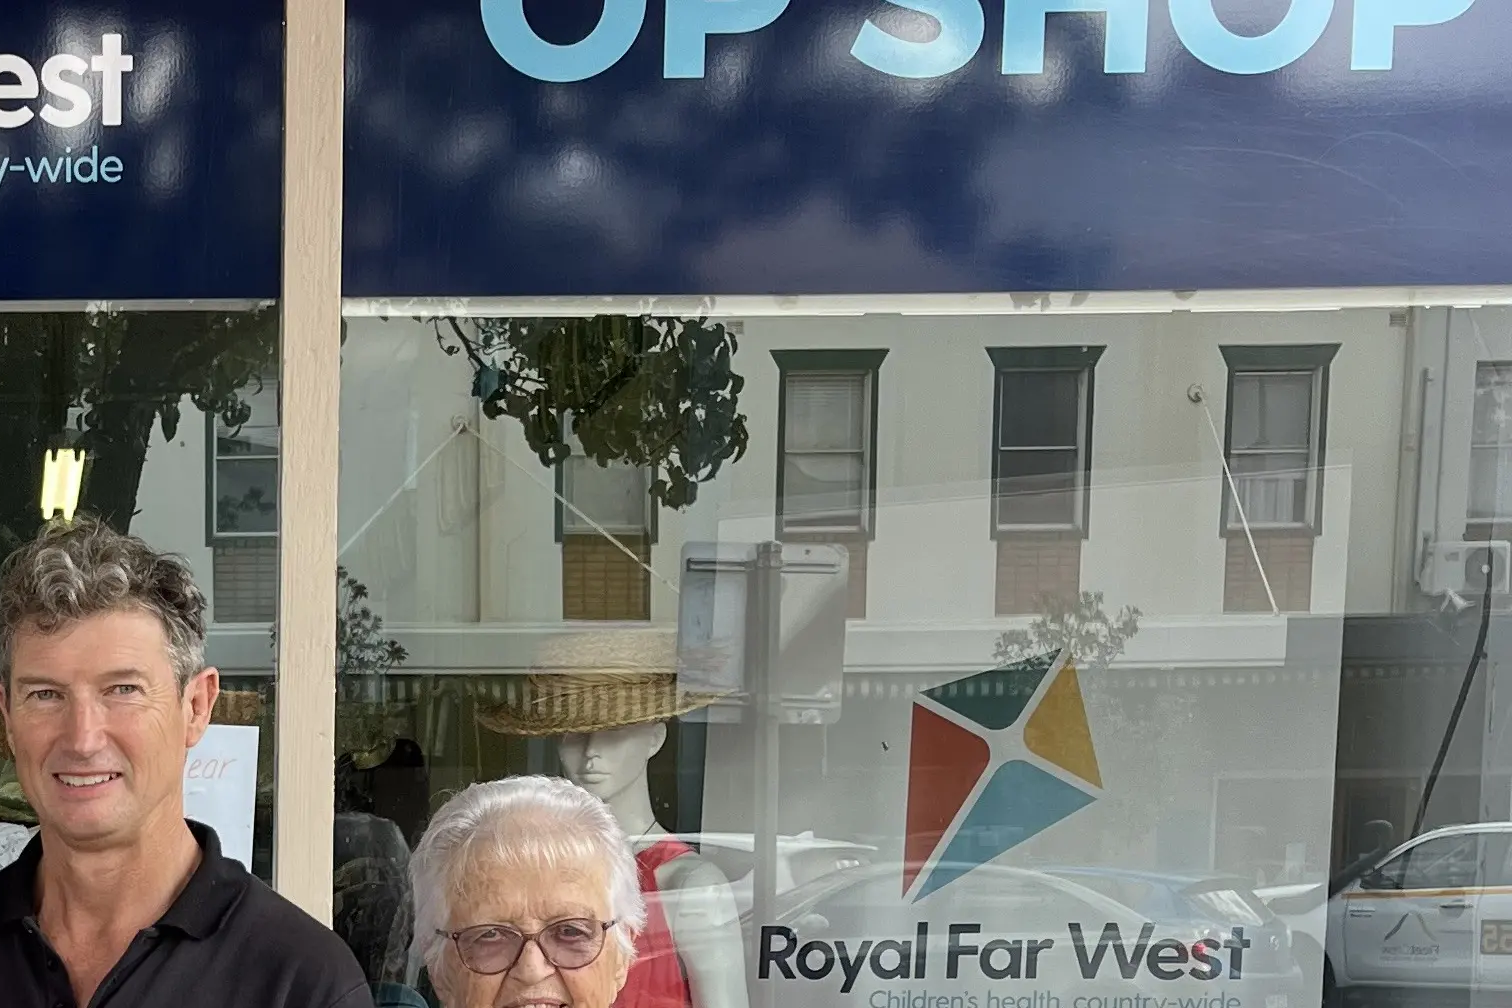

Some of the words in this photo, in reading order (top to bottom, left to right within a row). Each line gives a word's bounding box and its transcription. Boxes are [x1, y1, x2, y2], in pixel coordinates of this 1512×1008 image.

[188, 757, 237, 780] ear
[758, 921, 929, 994] Royal
[946, 922, 1054, 981] Far
[1068, 921, 1251, 981] West
